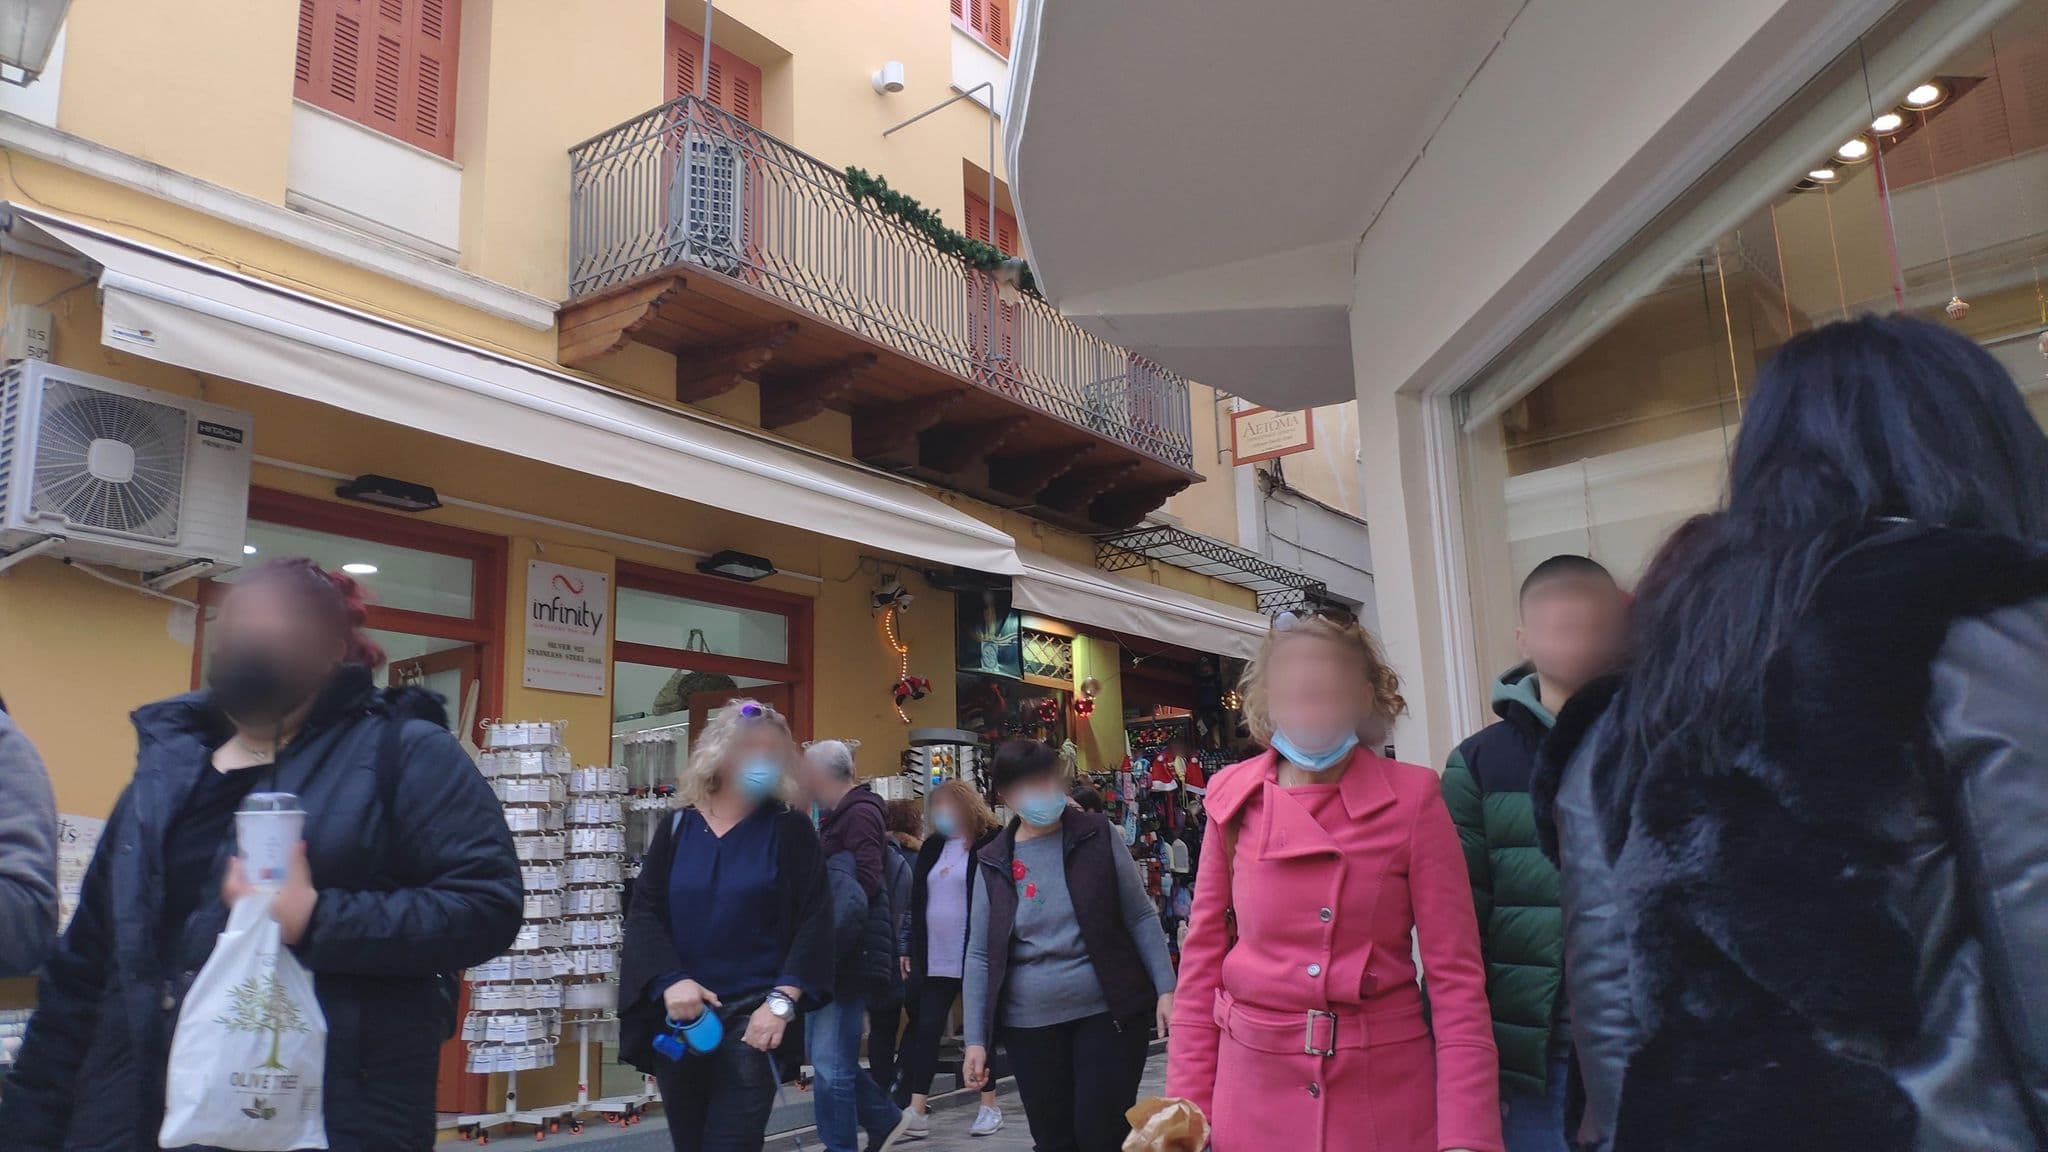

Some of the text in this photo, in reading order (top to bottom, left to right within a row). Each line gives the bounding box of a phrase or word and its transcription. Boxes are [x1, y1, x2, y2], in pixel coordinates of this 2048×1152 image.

[199, 424, 241, 440] HITACHI
[532, 596, 603, 636] infinity
[230, 1072, 270, 1089] OLIVE
